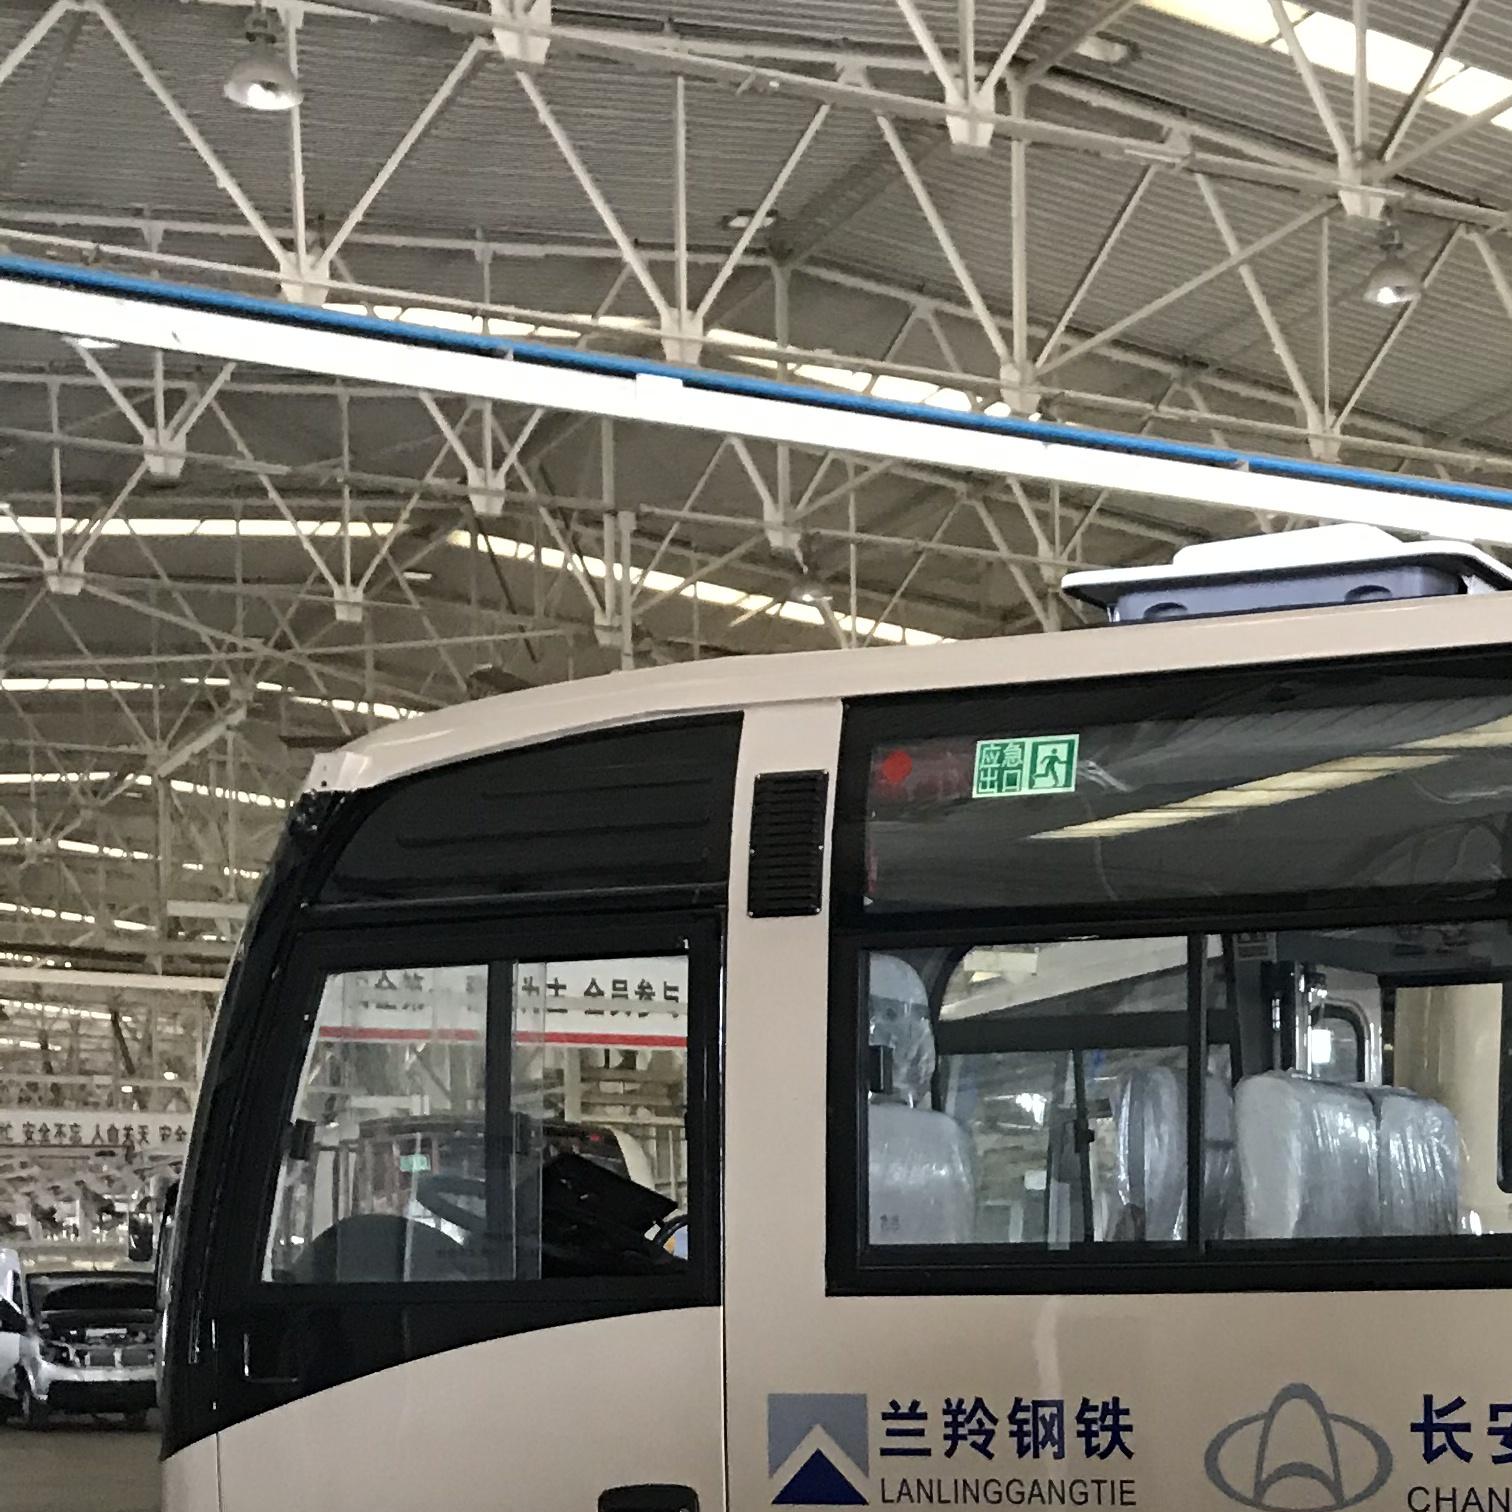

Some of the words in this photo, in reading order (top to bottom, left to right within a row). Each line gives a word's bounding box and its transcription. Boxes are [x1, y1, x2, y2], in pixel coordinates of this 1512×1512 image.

[980, 742, 1024, 769] 应急
[978, 767, 1022, 794] 出口
[879, 1395, 1135, 1461] 兰羚钢铁
[880, 1478, 1137, 1507] LANLINGGANGTIE
